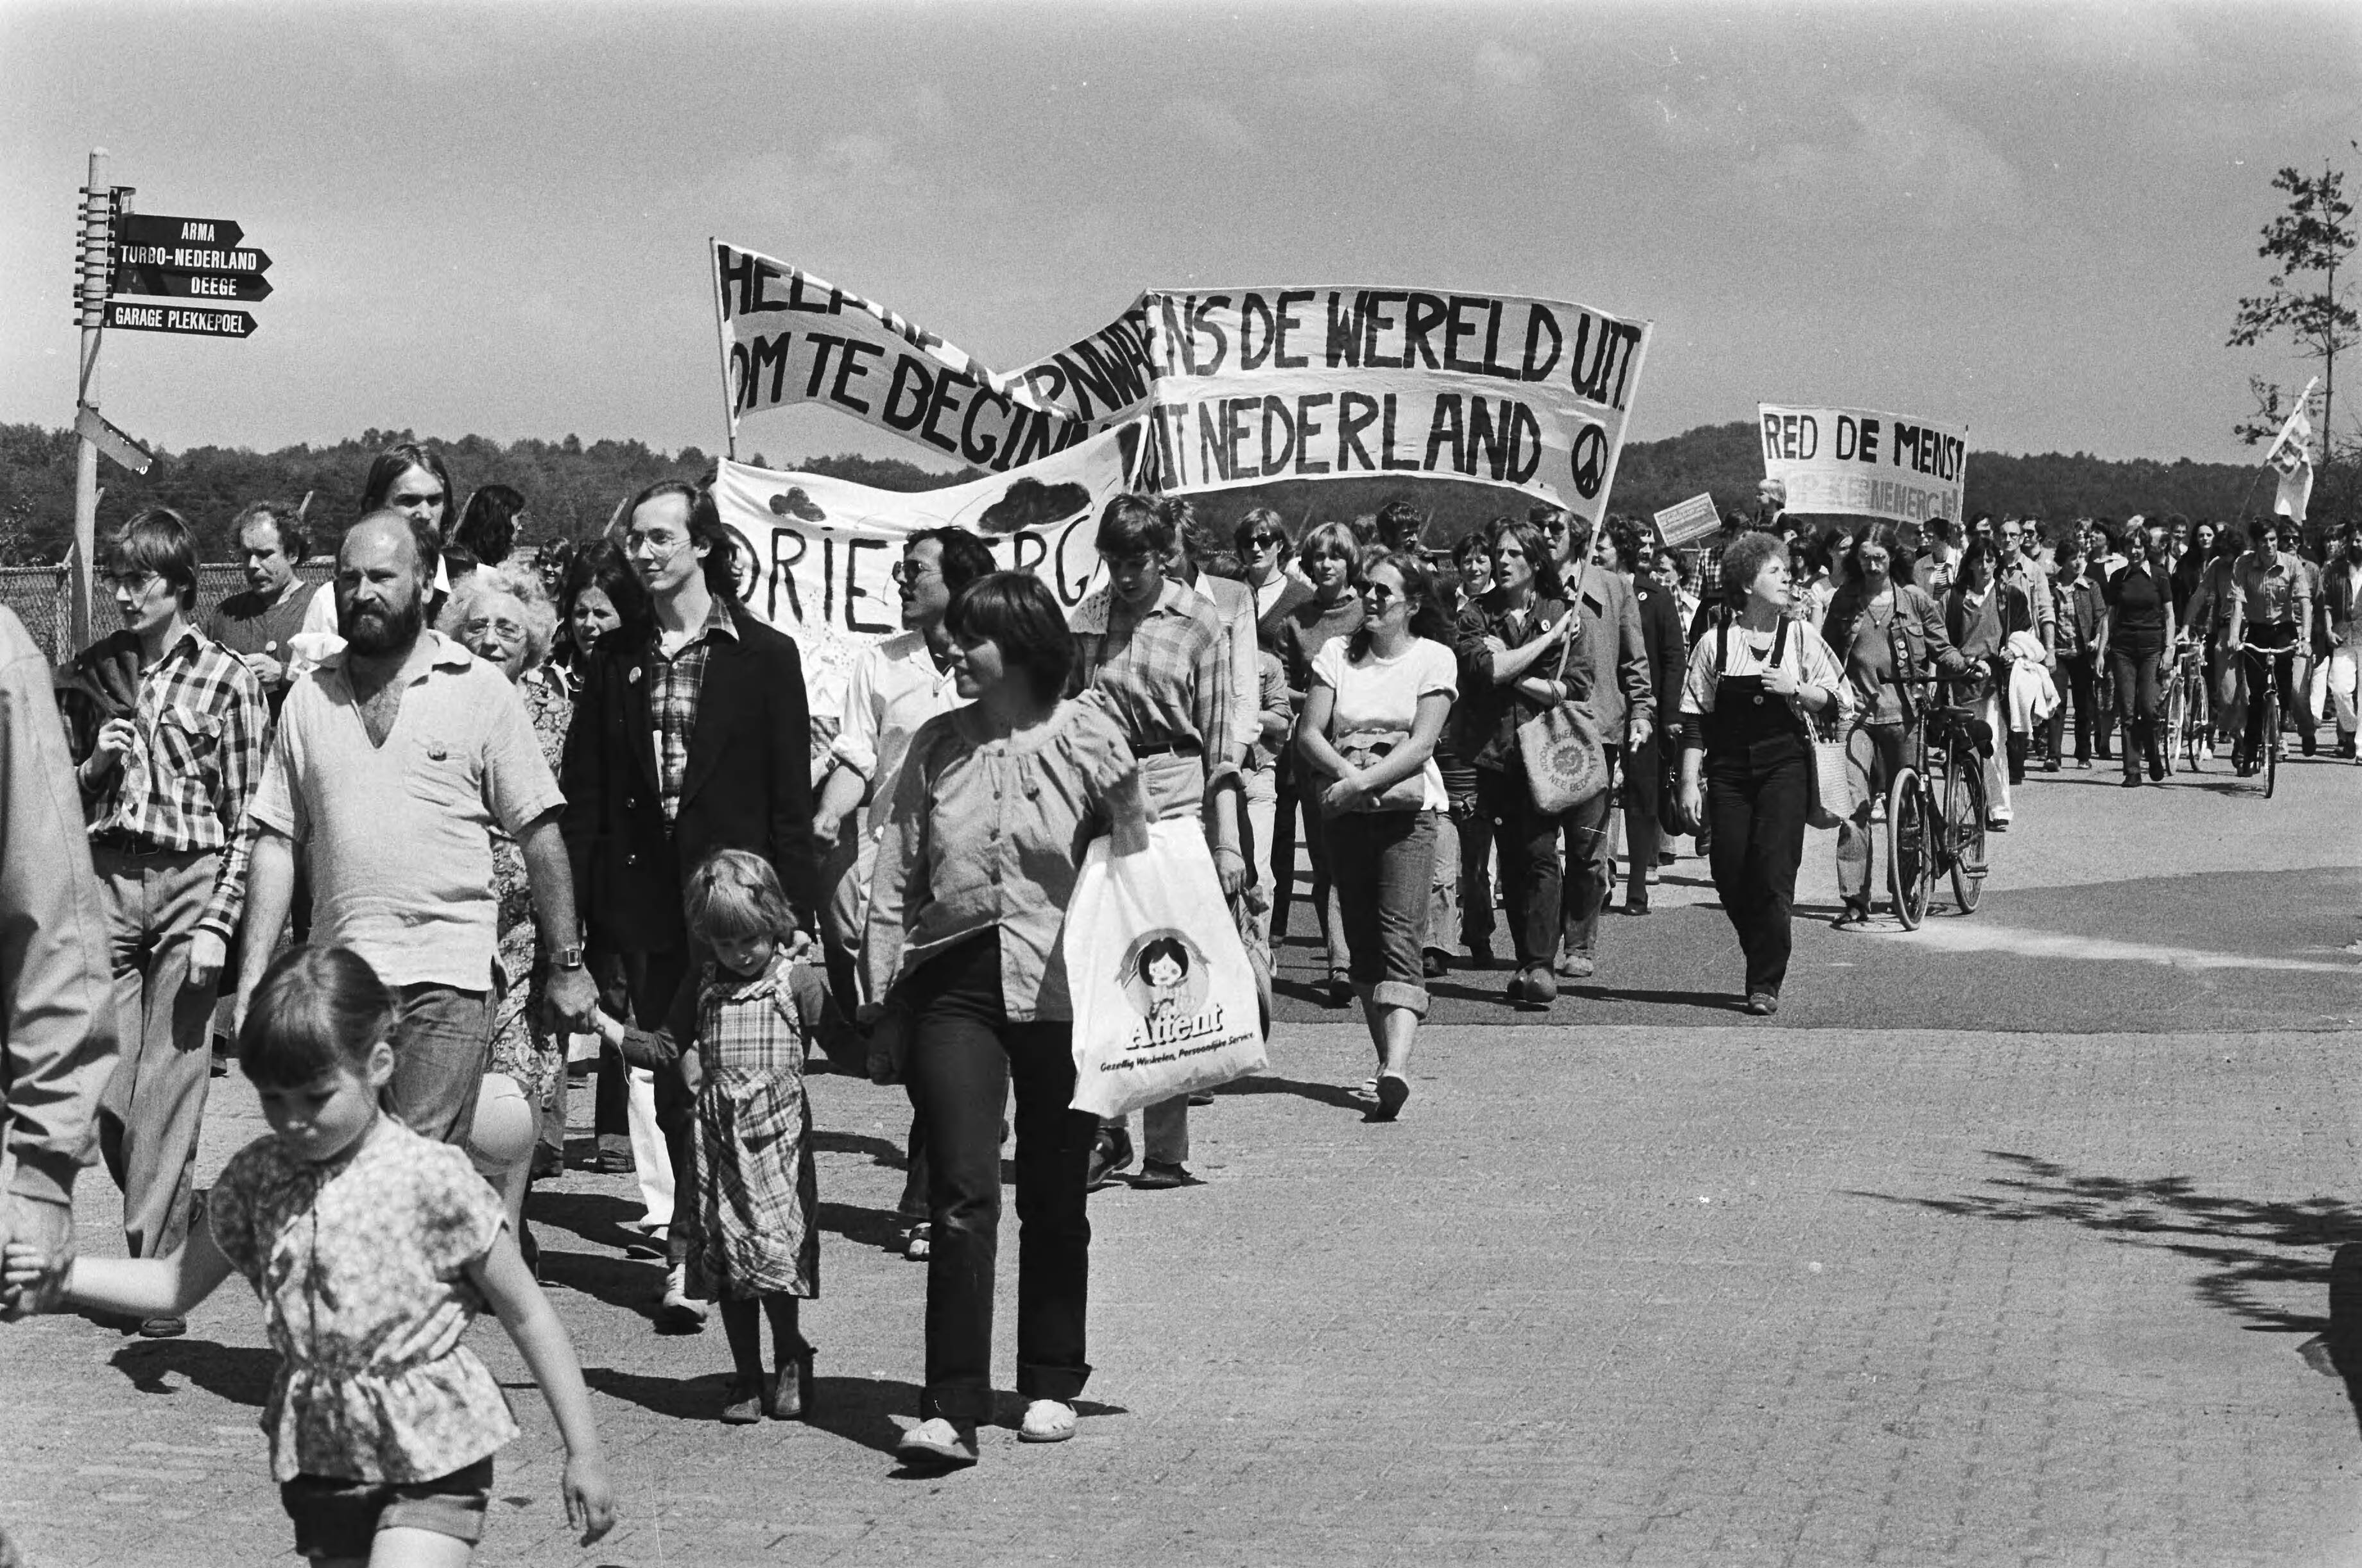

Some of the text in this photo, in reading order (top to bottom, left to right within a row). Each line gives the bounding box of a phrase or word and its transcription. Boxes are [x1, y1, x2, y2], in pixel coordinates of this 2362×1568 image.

[181, 222, 215, 242] ARMA
[120, 245, 257, 271] TURBO-NEDERLAND
[191, 277, 237, 296] DEEGE
[116, 307, 245, 334] GARAGE PLEKKEPOEL
[1240, 289, 1316, 371] DE
[1325, 289, 1562, 383] WERELD
[806, 331, 885, 415] TE
[1763, 413, 1965, 483] RED DE MENS!
[1126, 1002, 1224, 1050] Attent
